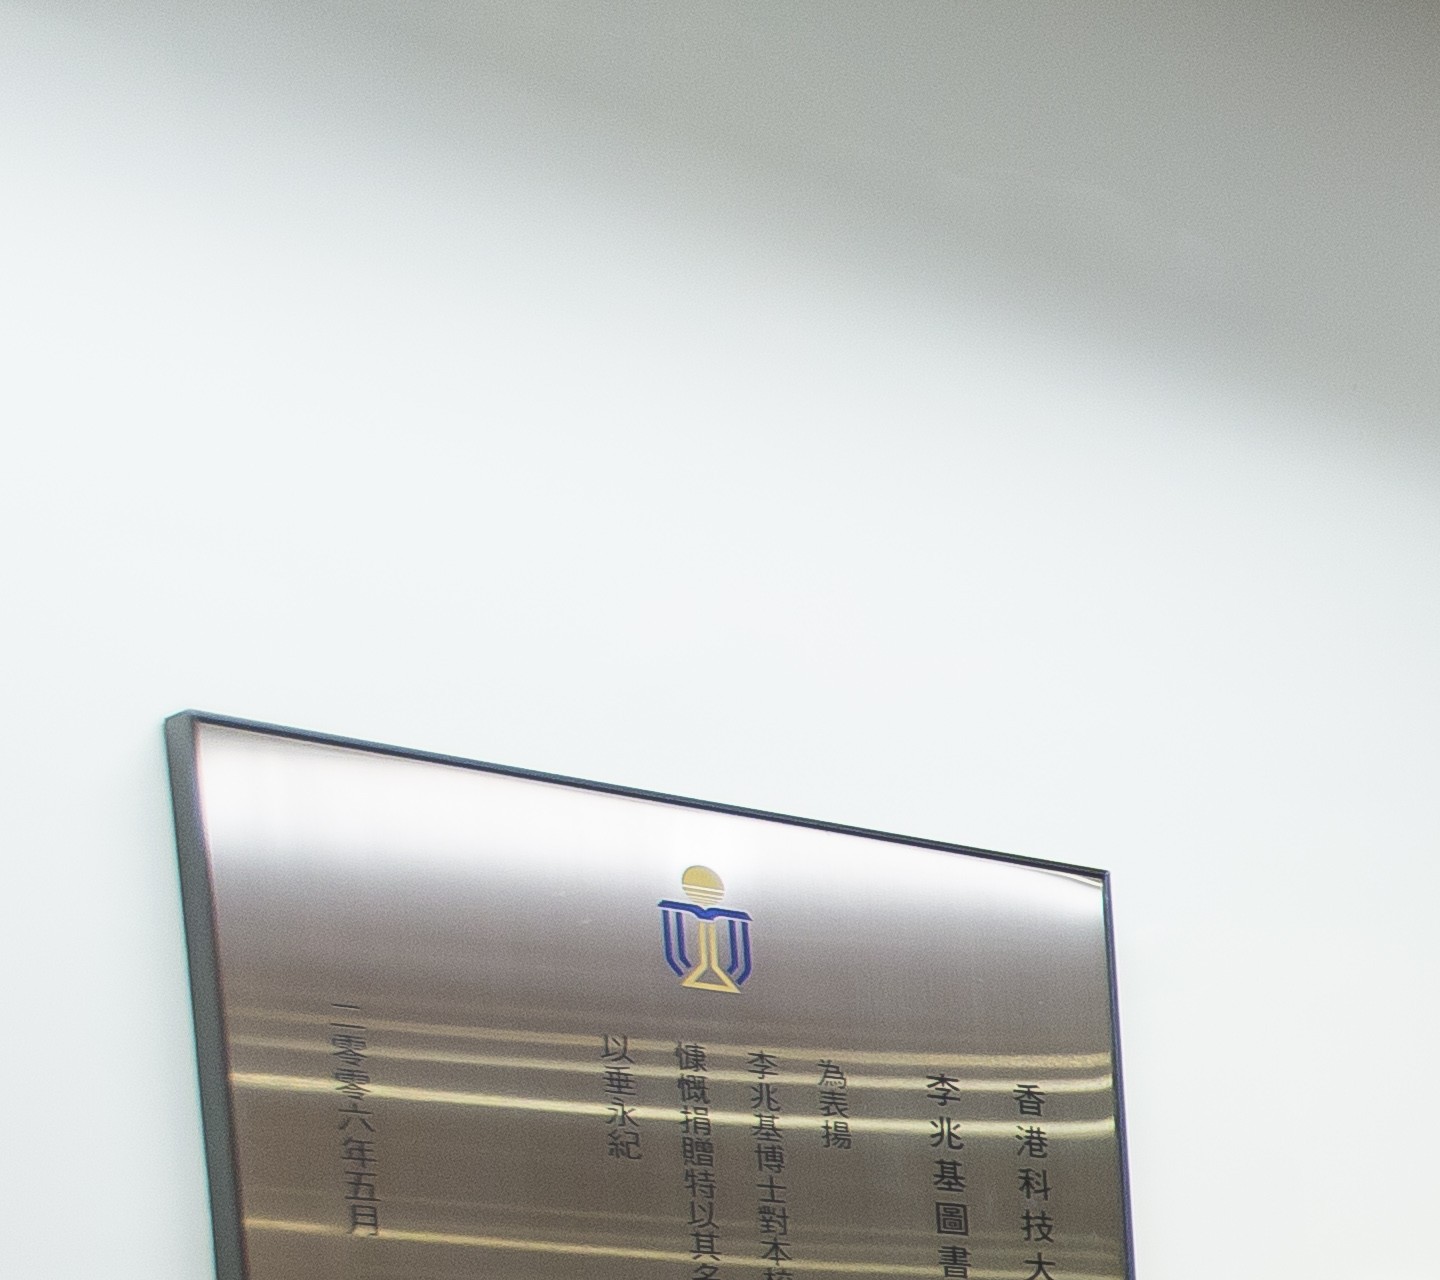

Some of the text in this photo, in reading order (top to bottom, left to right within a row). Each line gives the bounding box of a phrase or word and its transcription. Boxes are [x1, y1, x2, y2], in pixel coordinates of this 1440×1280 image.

[330, 1003, 381, 1236] 二零零六年五月
[601, 1033, 642, 1160] 以垂永紀
[817, 1058, 853, 1150] 為表揚
